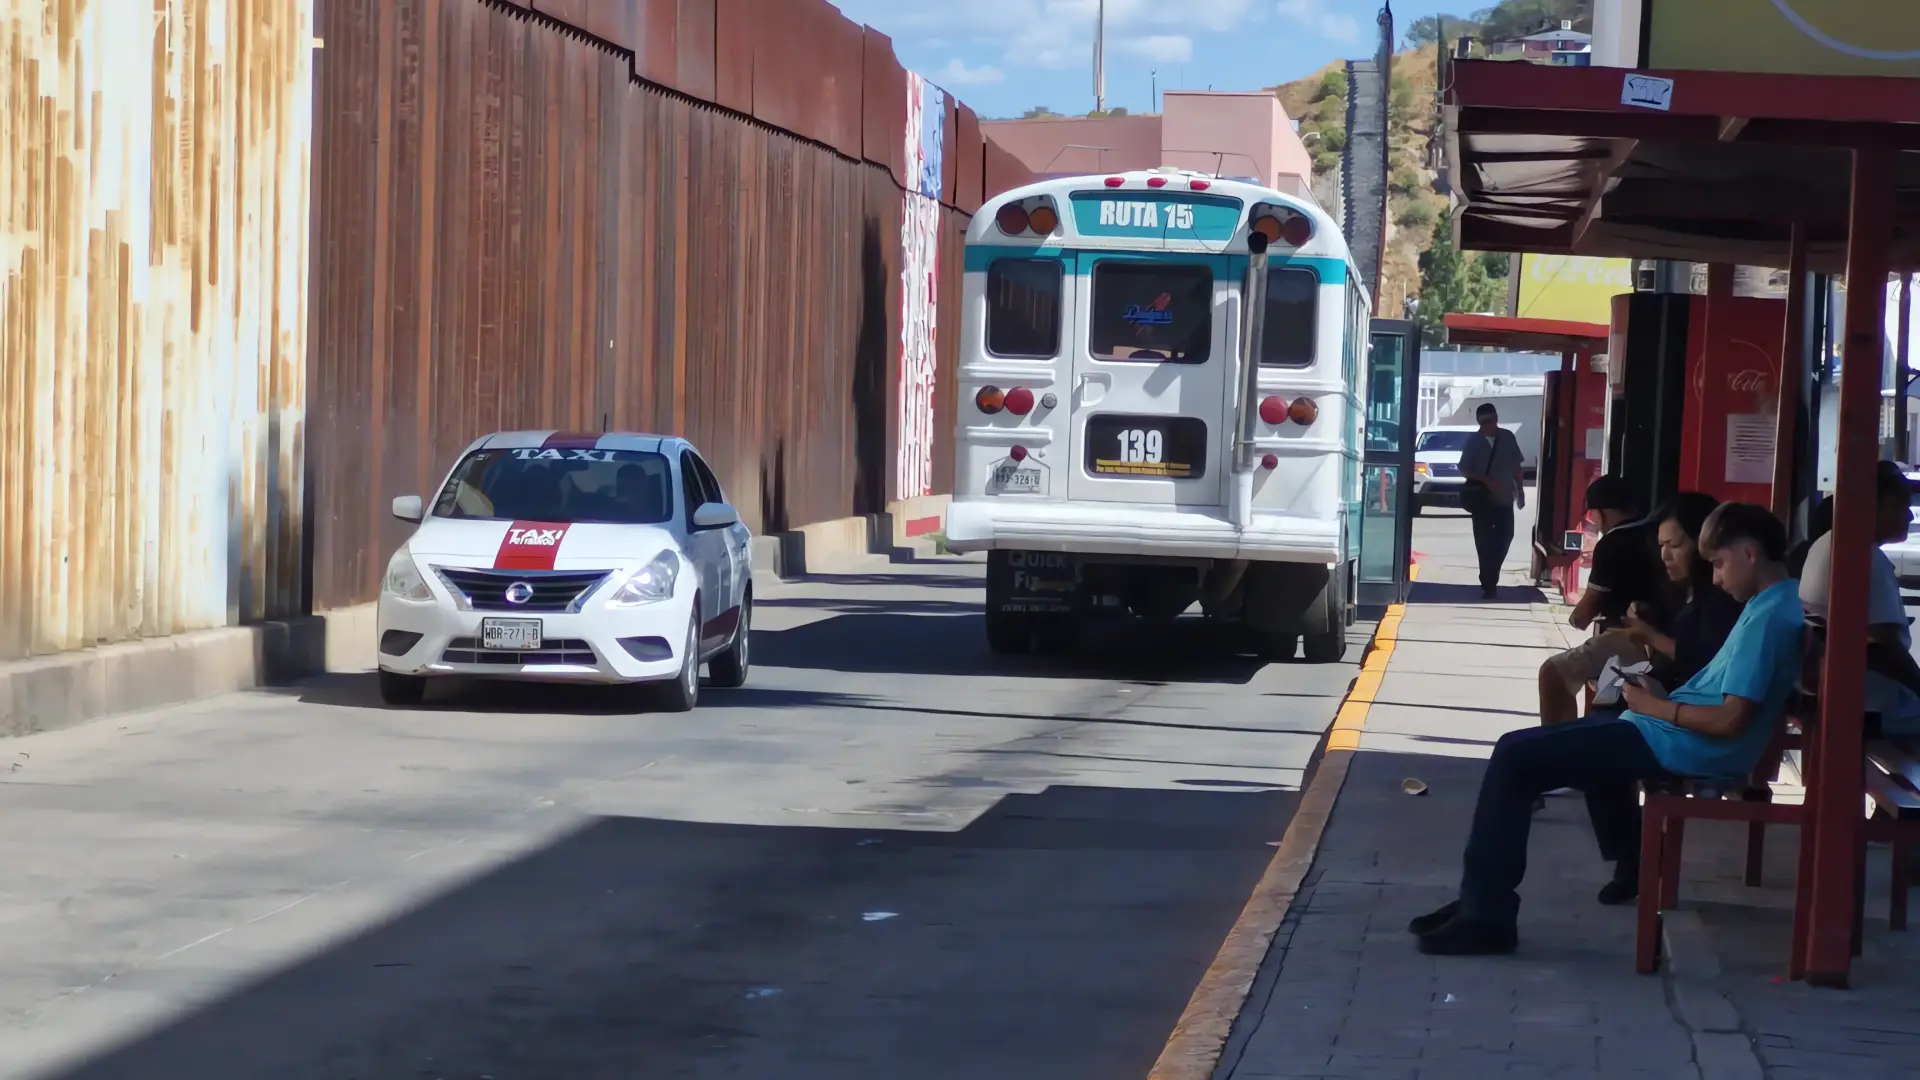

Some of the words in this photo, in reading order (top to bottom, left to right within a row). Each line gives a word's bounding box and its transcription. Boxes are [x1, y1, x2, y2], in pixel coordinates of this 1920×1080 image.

[1100, 200, 1158, 228] RUTA
[1164, 203, 1194, 229] 15
[512, 448, 617, 462] TAXI
[1117, 429, 1163, 464] 139
[509, 529, 564, 545] TAXI
